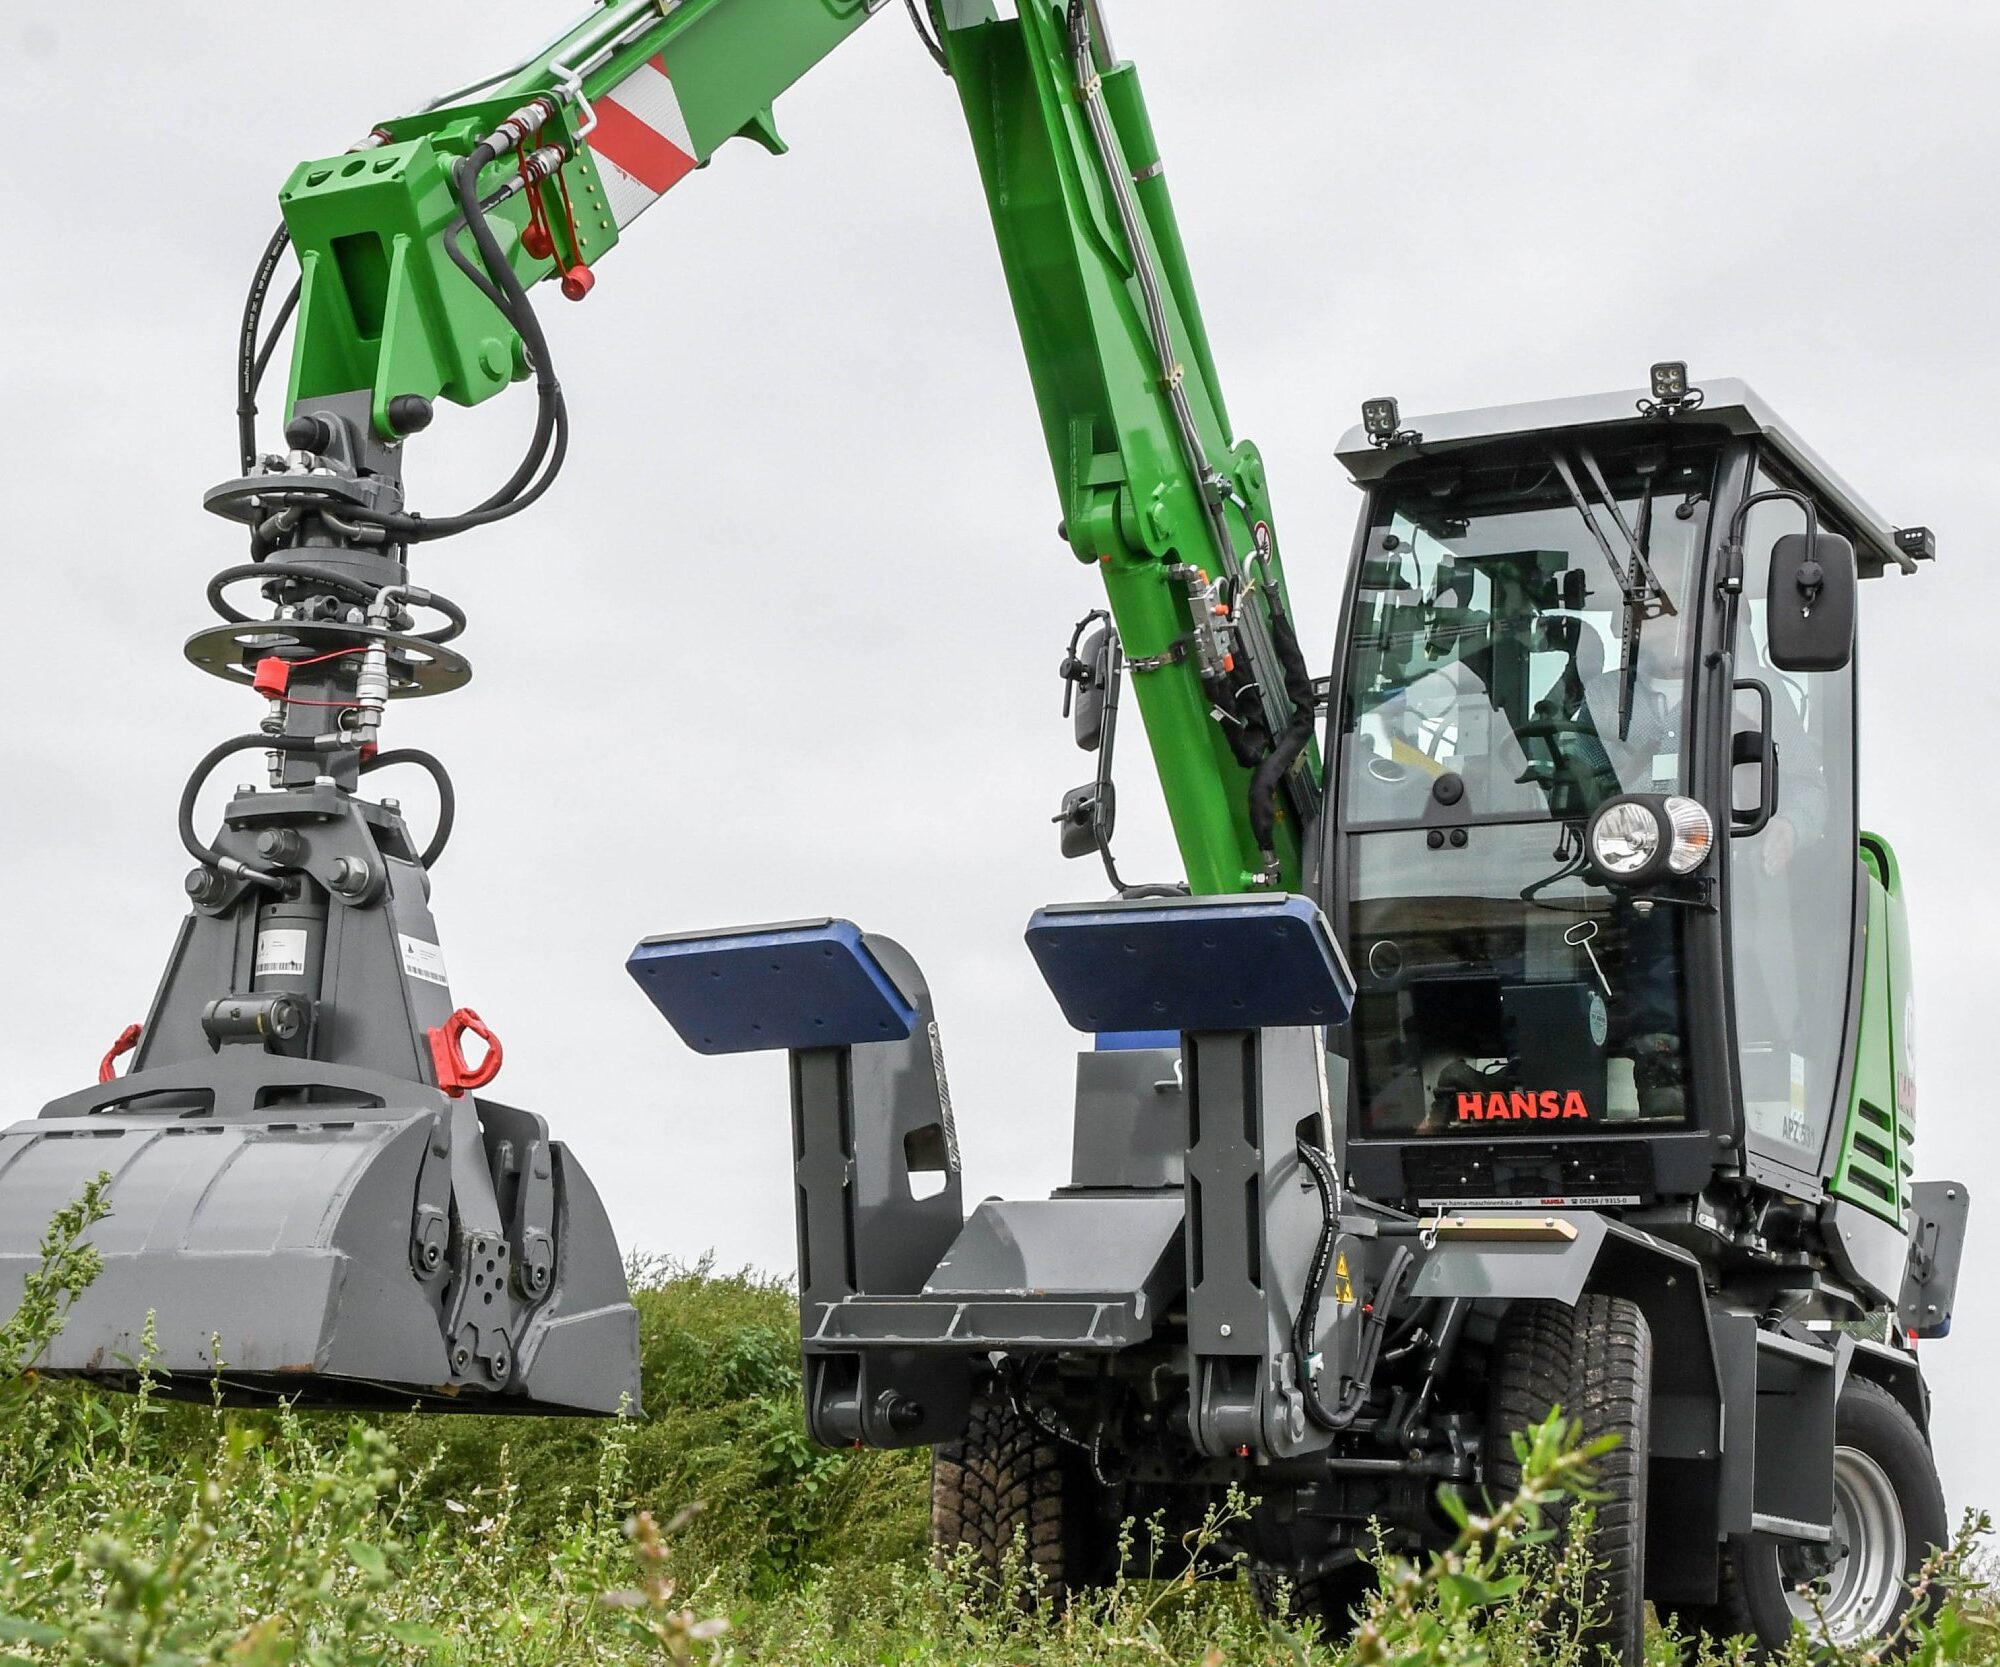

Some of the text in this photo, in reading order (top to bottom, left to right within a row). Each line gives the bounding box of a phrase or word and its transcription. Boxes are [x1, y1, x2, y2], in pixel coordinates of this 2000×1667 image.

[1457, 1090, 1588, 1120] HANSA
[1782, 1115, 1800, 1144] APZ
[1431, 1199, 1523, 1207] www.hansa-maschinenbau.de
